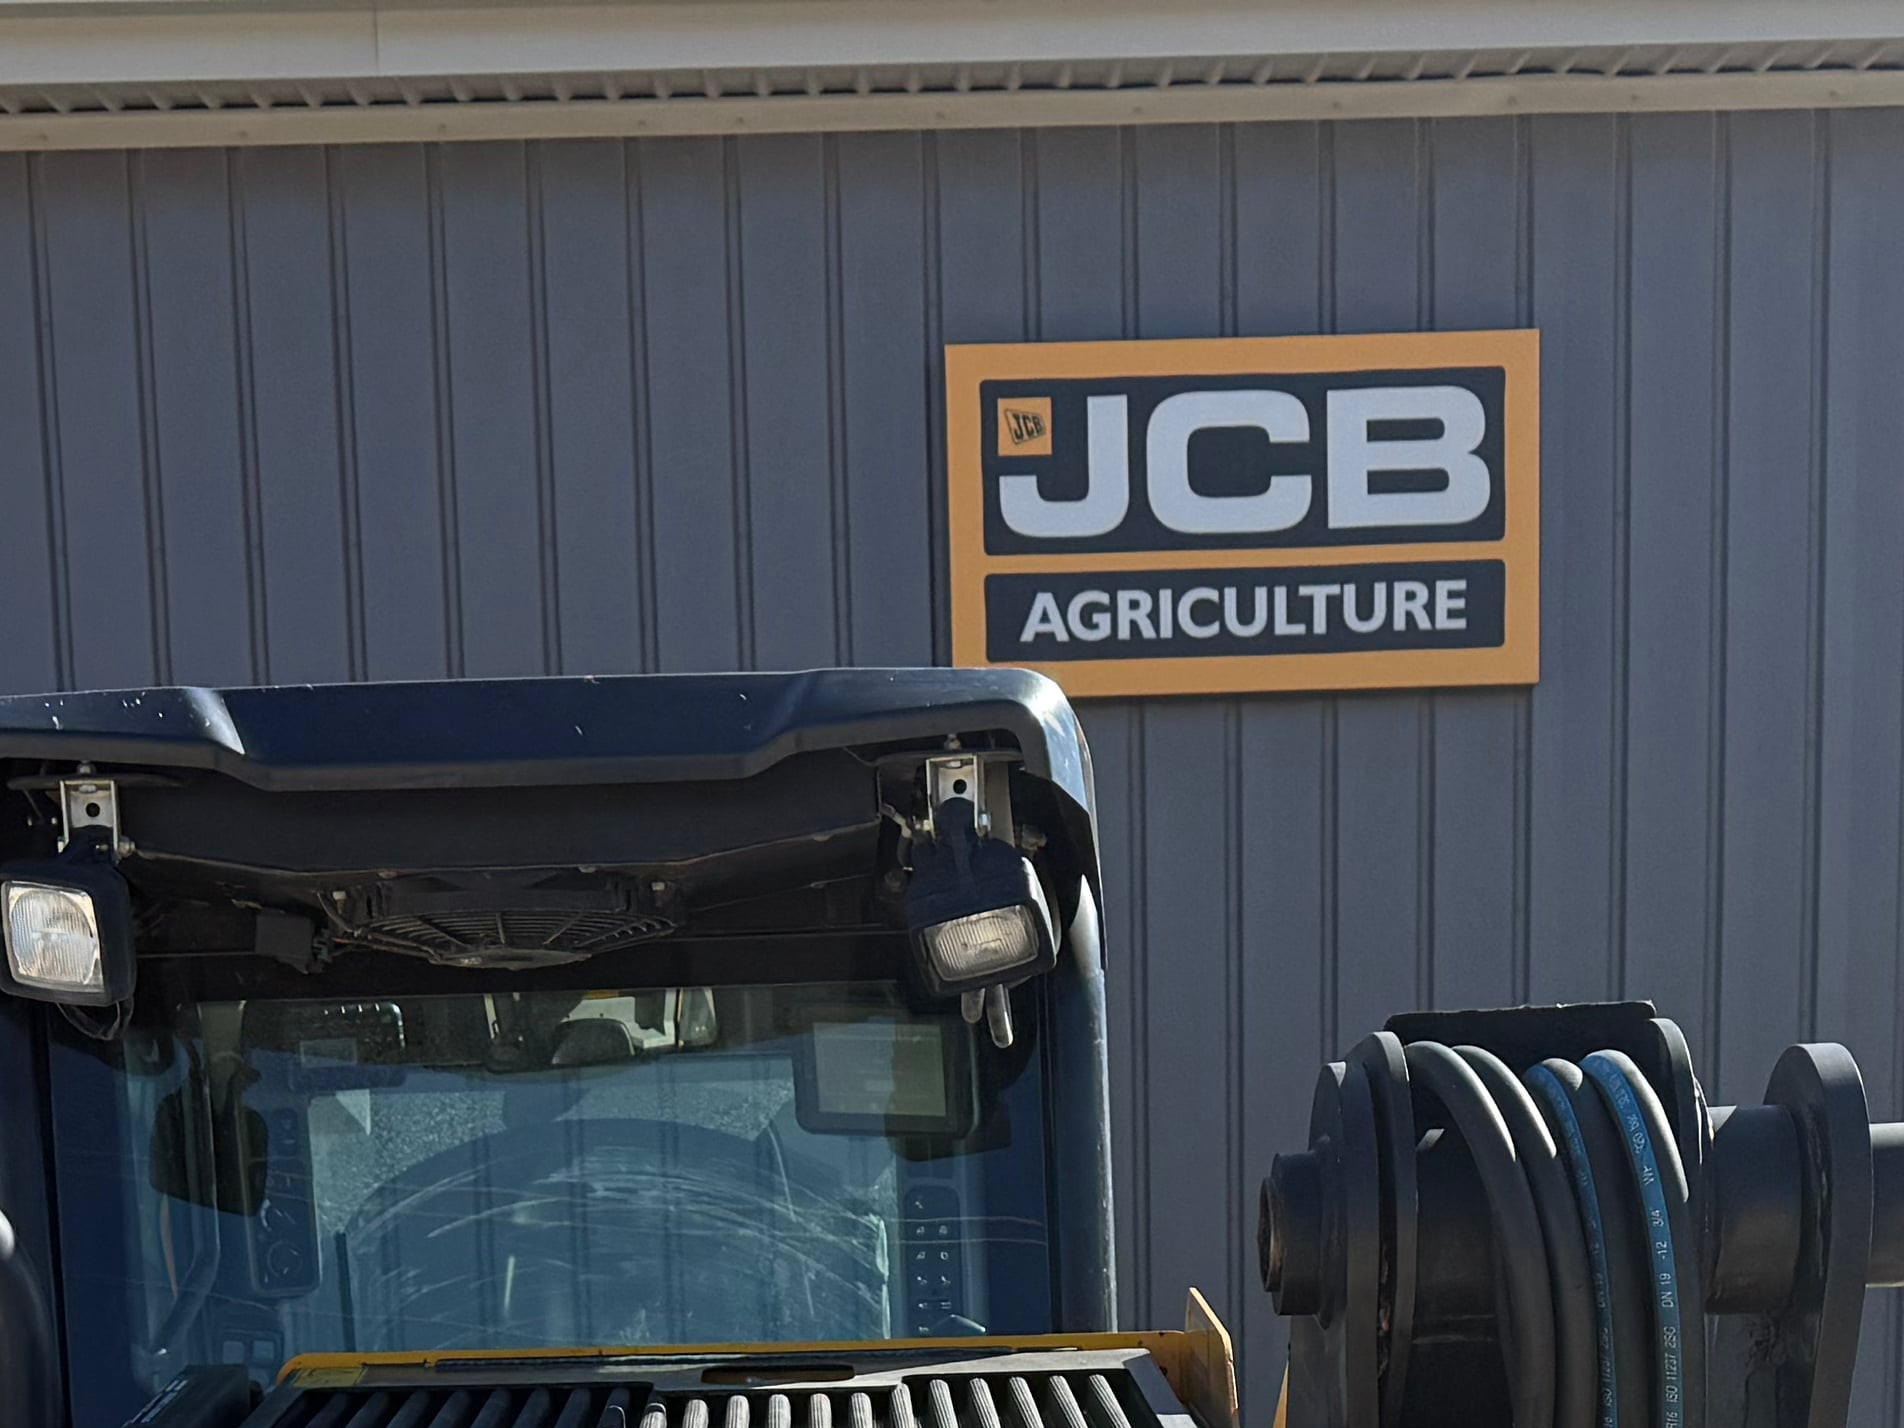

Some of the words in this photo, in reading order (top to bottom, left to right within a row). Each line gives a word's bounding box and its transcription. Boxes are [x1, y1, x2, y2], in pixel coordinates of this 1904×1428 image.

[998, 384, 1491, 538] JCB
[1020, 579, 1467, 644] AGRICULTURE
[1659, 1272, 1672, 1286] 19
[1660, 1290, 1675, 1309] DN
